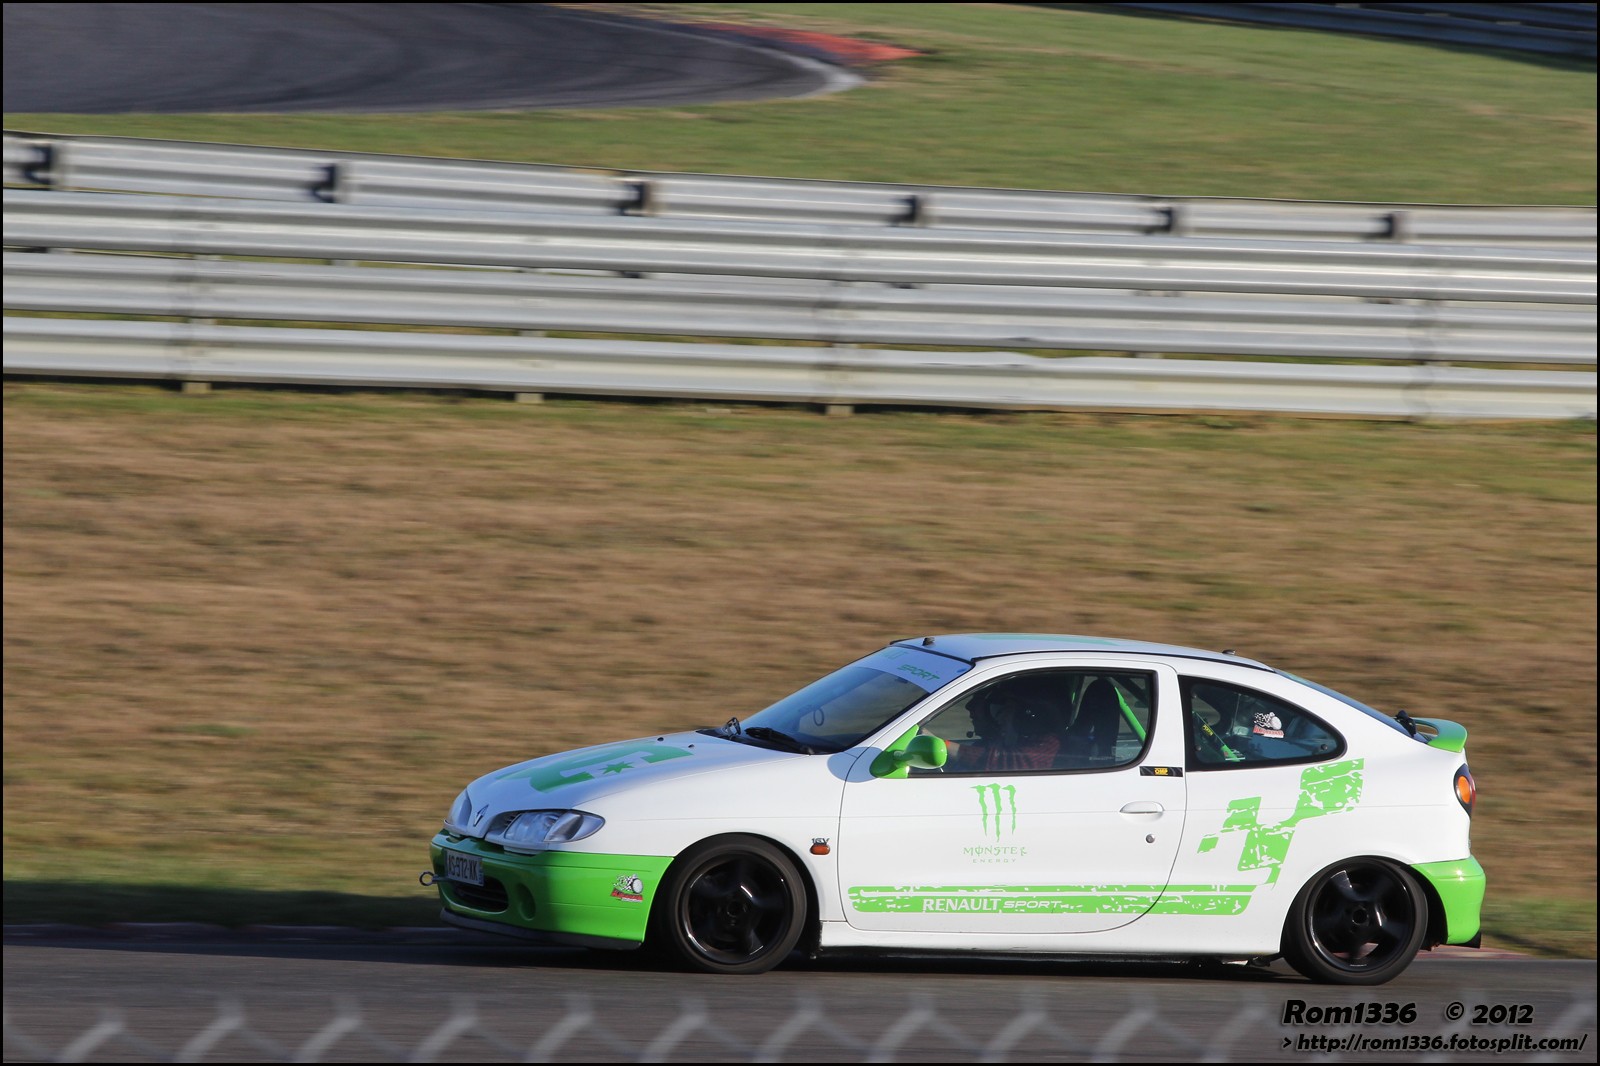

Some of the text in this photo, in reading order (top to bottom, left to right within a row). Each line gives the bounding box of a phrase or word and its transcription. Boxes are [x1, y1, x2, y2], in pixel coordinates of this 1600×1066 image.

[897, 664, 940, 681] SPORT
[963, 845, 1027, 857] MONSTER
[922, 898, 1061, 911] RENAULT SPORT
